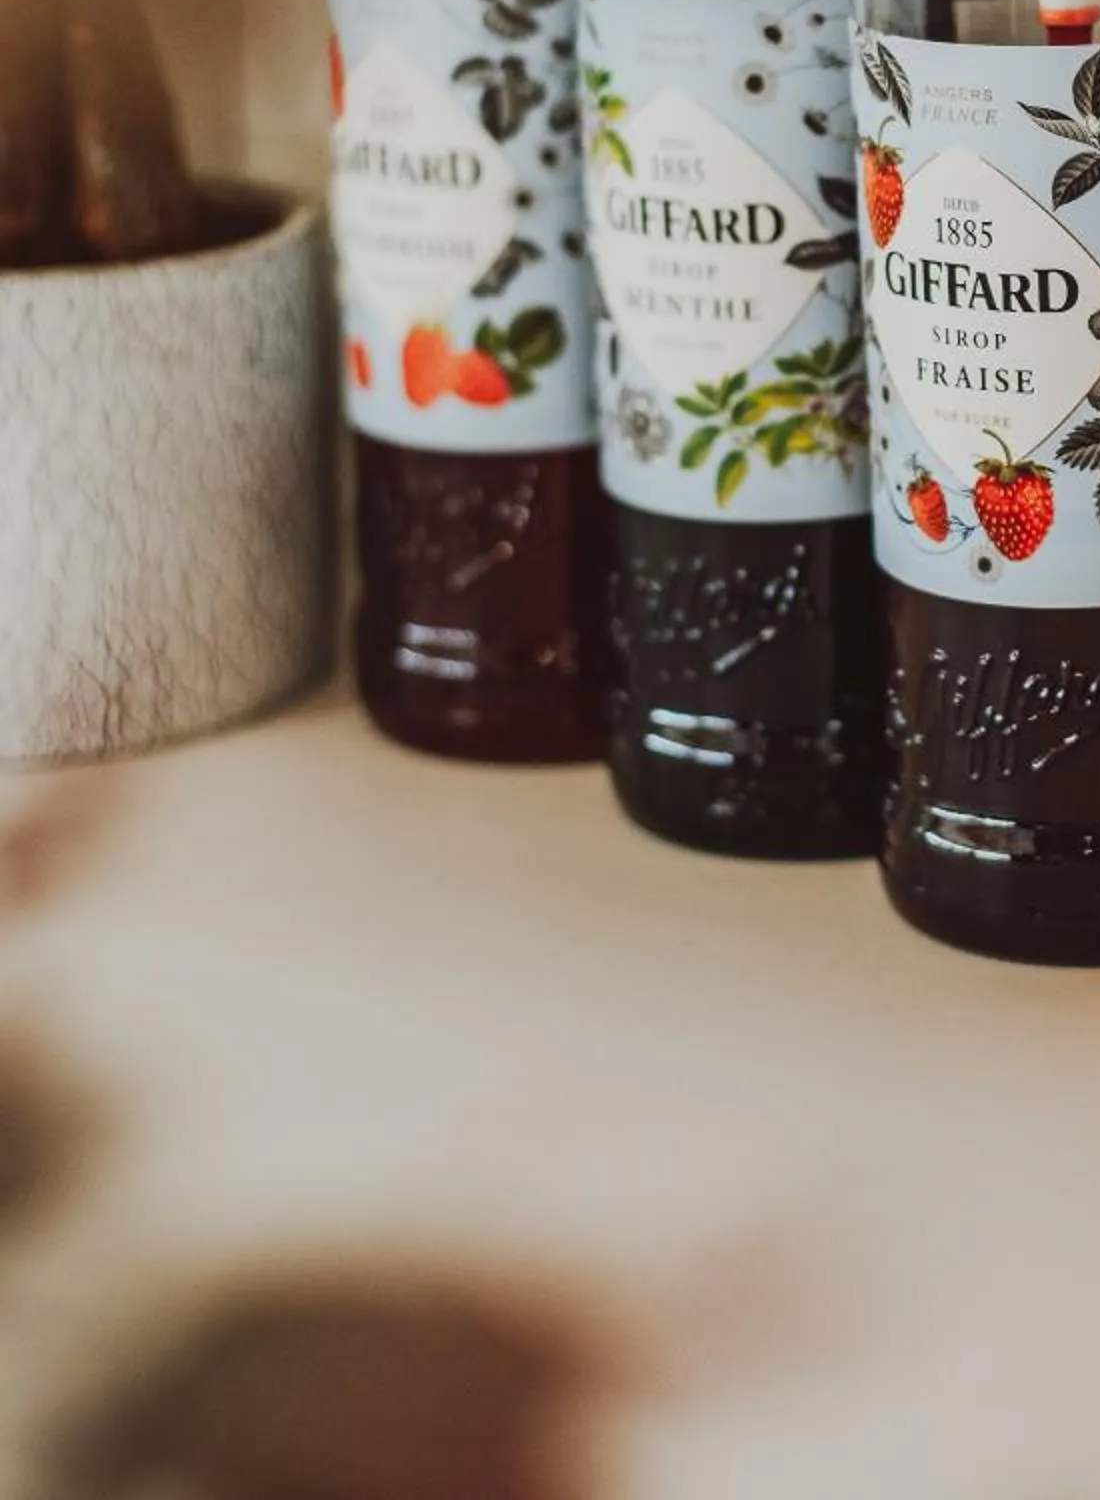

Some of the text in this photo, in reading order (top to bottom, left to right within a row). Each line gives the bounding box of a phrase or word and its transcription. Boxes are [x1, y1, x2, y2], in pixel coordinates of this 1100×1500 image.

[605, 187, 786, 245] GIFFARD
[935, 217, 993, 249] 1885
[884, 250, 1079, 314] GIFFARD
[931, 327, 1007, 351] SIROP
[916, 358, 1036, 396] FRAISE
